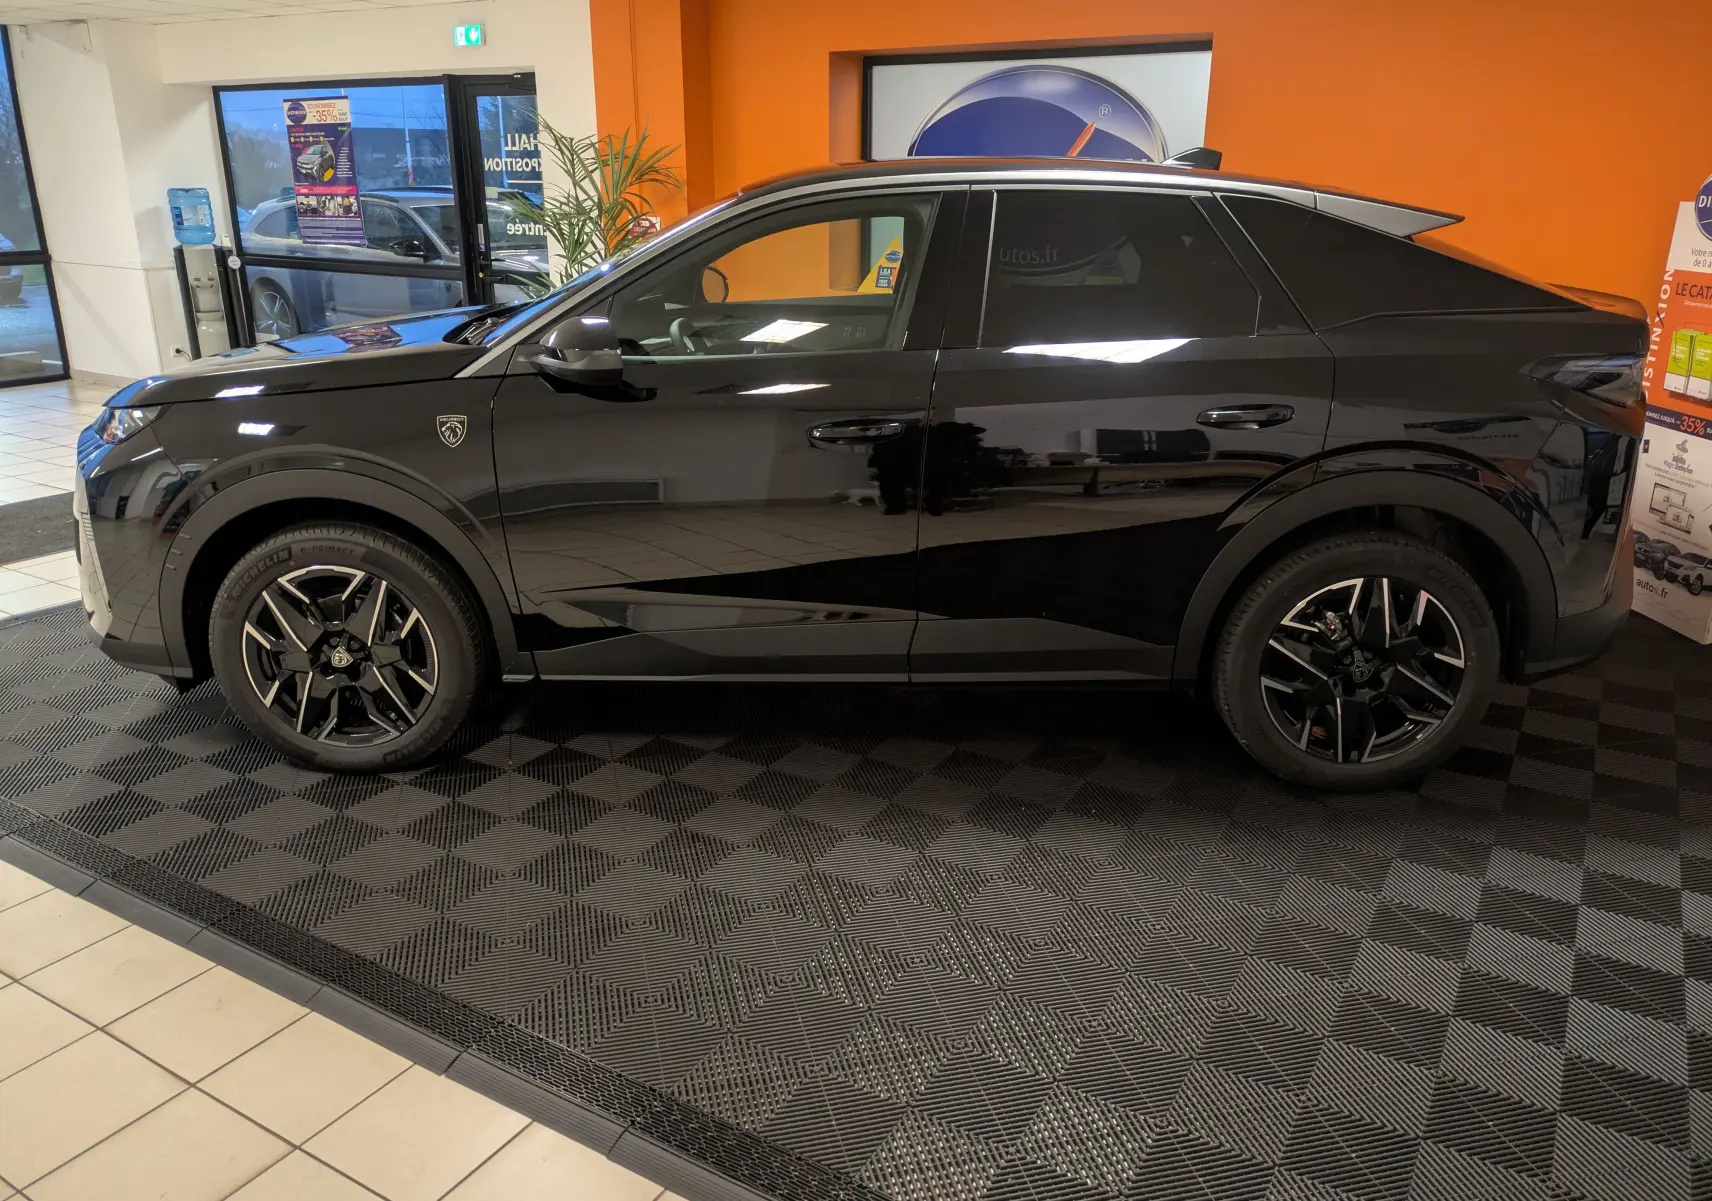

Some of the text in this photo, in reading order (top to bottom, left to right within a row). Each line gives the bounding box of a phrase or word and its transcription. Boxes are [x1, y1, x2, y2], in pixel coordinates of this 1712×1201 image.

[312, 109, 338, 122] -35%
[1691, 247, 1707, 257] Votre
[1693, 258, 1701, 267] de
[1675, 281, 1688, 296] LE
[1676, 415, 1706, 435] -35%
[231, 547, 292, 599] MICHELIN
[1636, 578, 1669, 599] autos.fr
